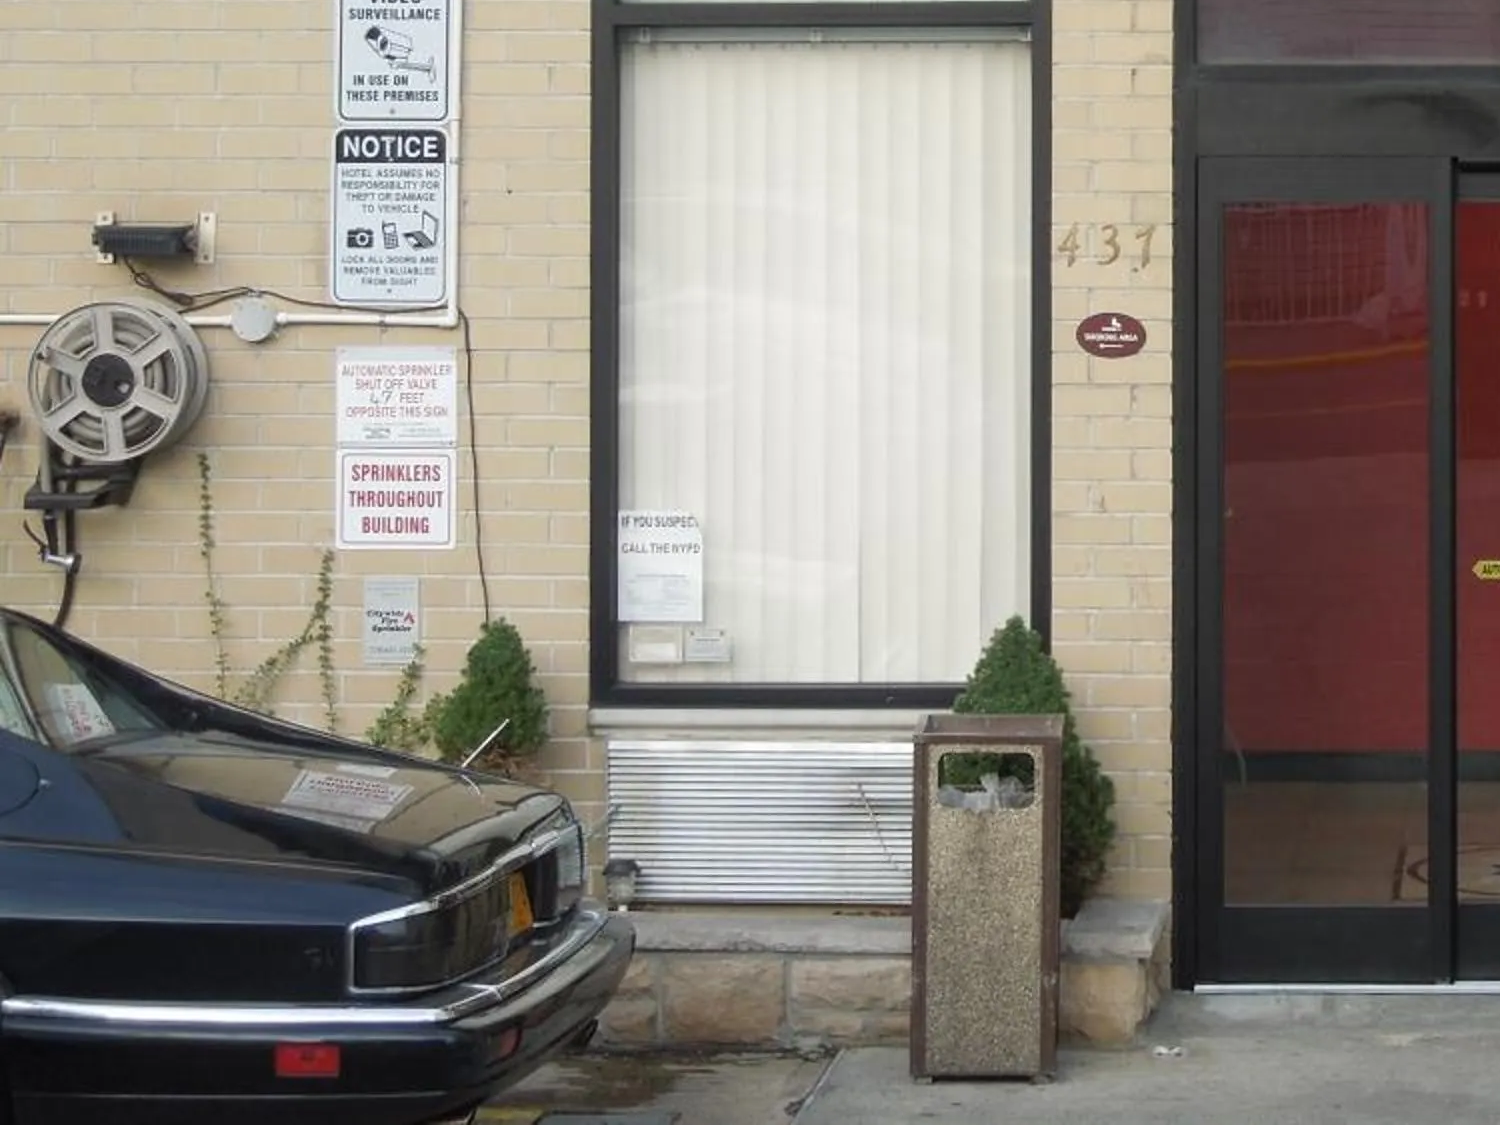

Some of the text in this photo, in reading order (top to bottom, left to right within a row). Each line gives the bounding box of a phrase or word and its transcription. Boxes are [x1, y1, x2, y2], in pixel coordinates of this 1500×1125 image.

[348, 8, 441, 21] SURVEILLANCE
[353, 75, 409, 86] IN USE ON
[346, 90, 439, 102] THESE PREMISES
[343, 136, 439, 158] NOTICE
[341, 180, 440, 190] RESPONSIBILITY FOR
[395, 192, 436, 202] DAMAGE
[361, 204, 420, 214] TO VEHICLE
[1057, 222, 1156, 268] 437
[341, 364, 452, 376] AUTOMATIC SPRINKLER
[355, 378, 438, 390] SHUT OFF VALVE
[399, 392, 424, 404] FEET
[345, 407, 448, 418] OPPOSITE THIS SIGN
[351, 464, 441, 482] SPRINKLERS
[349, 490, 444, 508] THROUGHOUT
[361, 516, 430, 534] BUILDING
[622, 542, 701, 554] CALL THE NYPD
